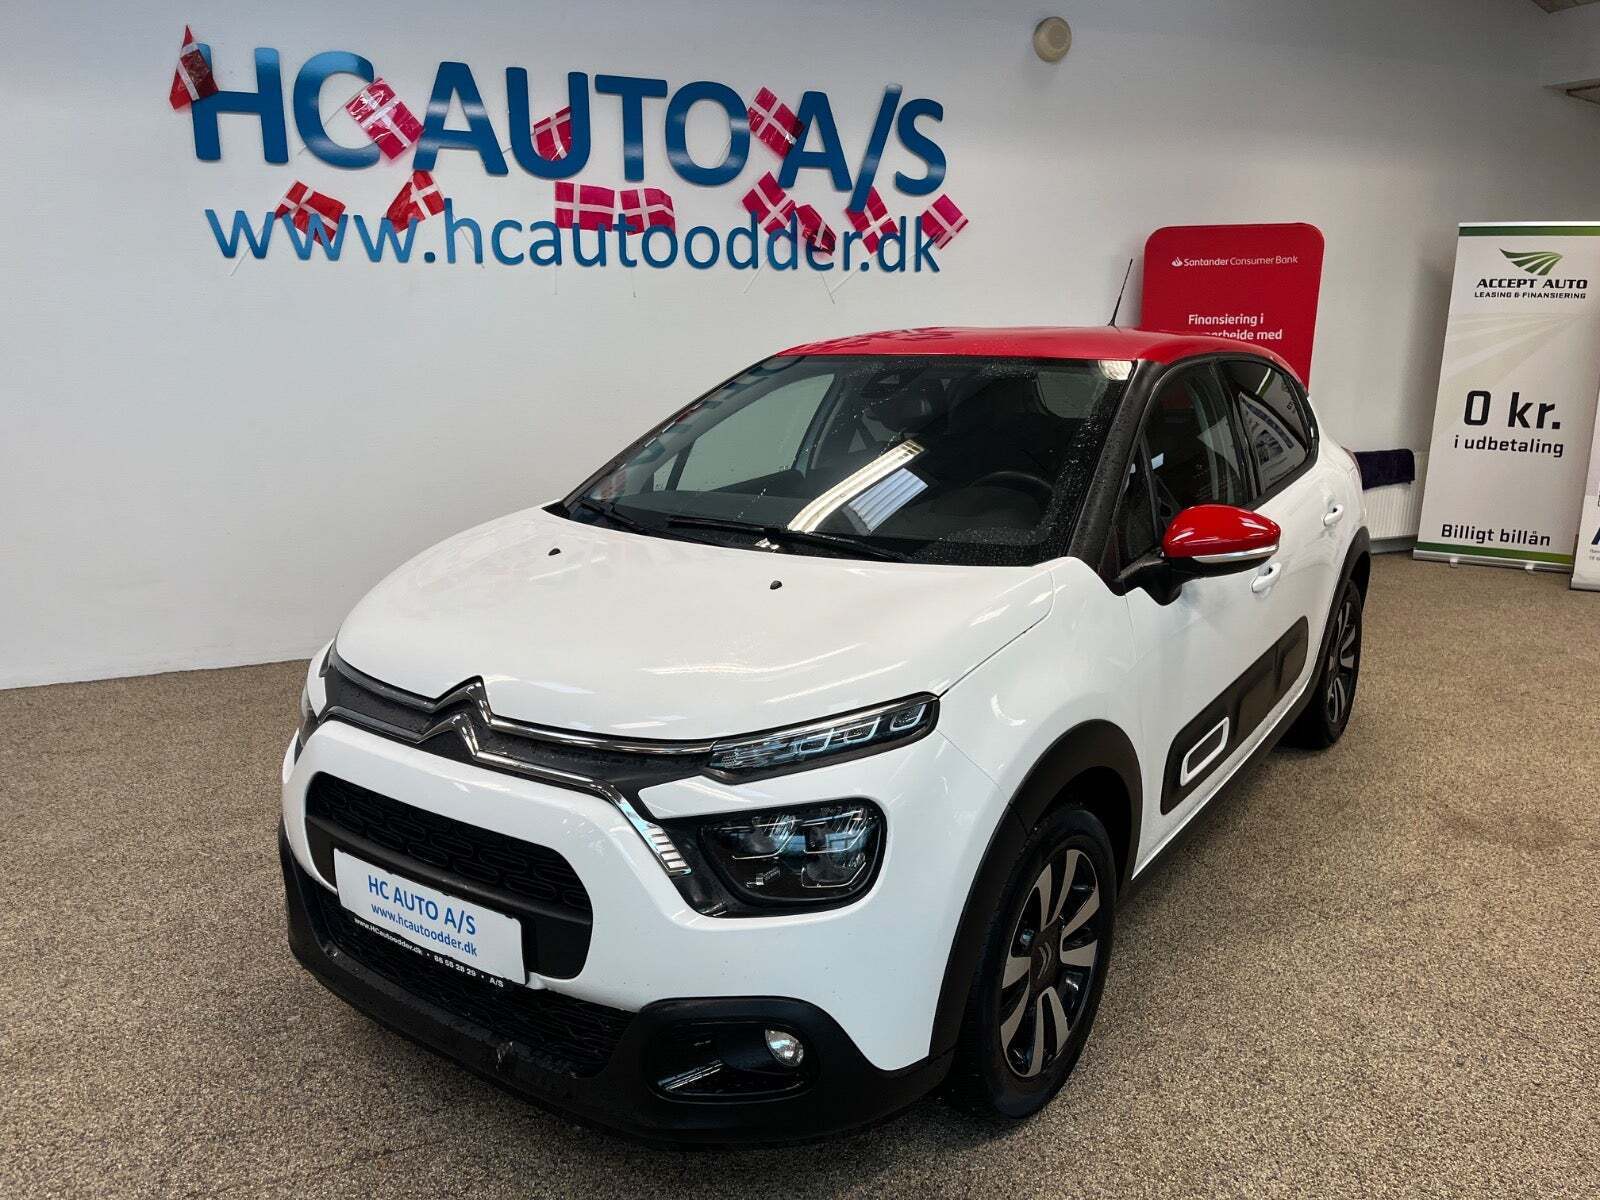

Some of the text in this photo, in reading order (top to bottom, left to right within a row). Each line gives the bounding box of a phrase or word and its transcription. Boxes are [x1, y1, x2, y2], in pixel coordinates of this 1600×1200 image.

[190, 42, 947, 213] HC AUTO A/S
[204, 197, 941, 273] www.hcautoodder.dk
[1183, 255, 1298, 267] Santander Consumer Bank
[1476, 278, 1588, 289] ACCEPT AUTO
[1188, 313, 1264, 327] Finansiering i
[1256, 328, 1283, 340] med
[1463, 390, 1561, 430] 0 kr.
[1454, 434, 1564, 458] i udbetaling
[1441, 523, 1495, 544] Billigt
[367, 874, 476, 936] HC AUTO A/S
[370, 903, 478, 957] www.hcautoodder.dk
[489, 977, 504, 988] A/S
